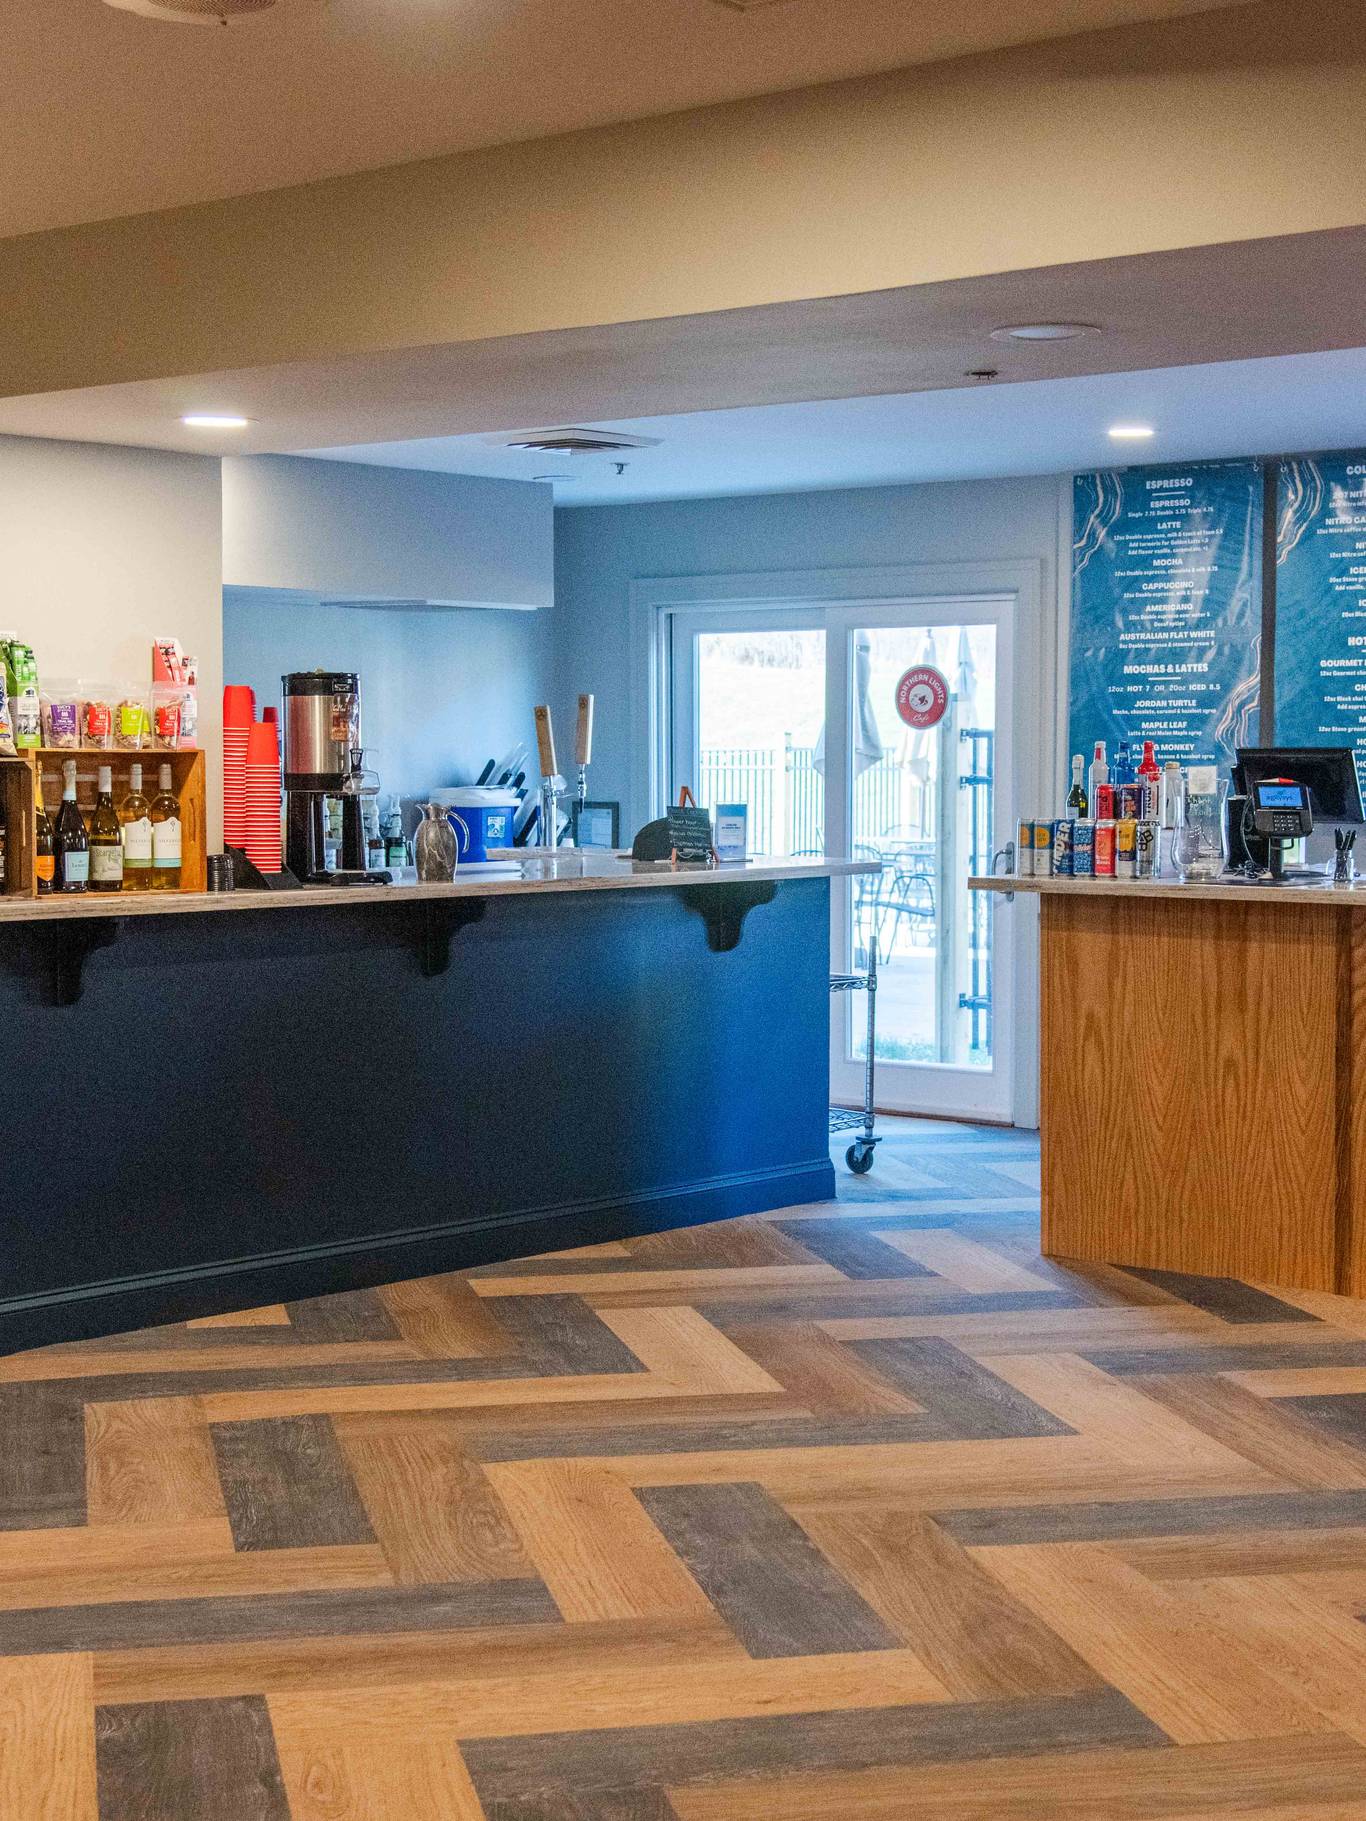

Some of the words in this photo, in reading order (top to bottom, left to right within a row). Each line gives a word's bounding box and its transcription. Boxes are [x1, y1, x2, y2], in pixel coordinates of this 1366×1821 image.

[1146, 478, 1193, 490] ESPRESSO
[1150, 498, 1190, 508] ESPRESSO
[1325, 517, 1352, 525] NITRO
[1158, 522, 1182, 530] LATTE
[1153, 558, 1183, 566] MOCHA
[1142, 581, 1194, 590] CAPPUCCINO
[1145, 603, 1192, 612] AMERICANO
[1120, 632, 1168, 640] AUSTRALIAN
[1190, 630, 1216, 638] WHITE
[1123, 664, 1166, 674] MOCHAS
[1167, 664, 1174, 673] &
[1176, 663, 1208, 673] LATTES
[1320, 660, 1363, 668] GOURMET
[900, 673, 928, 704] NORTHERN
[928, 676, 944, 704] LIGHTS
